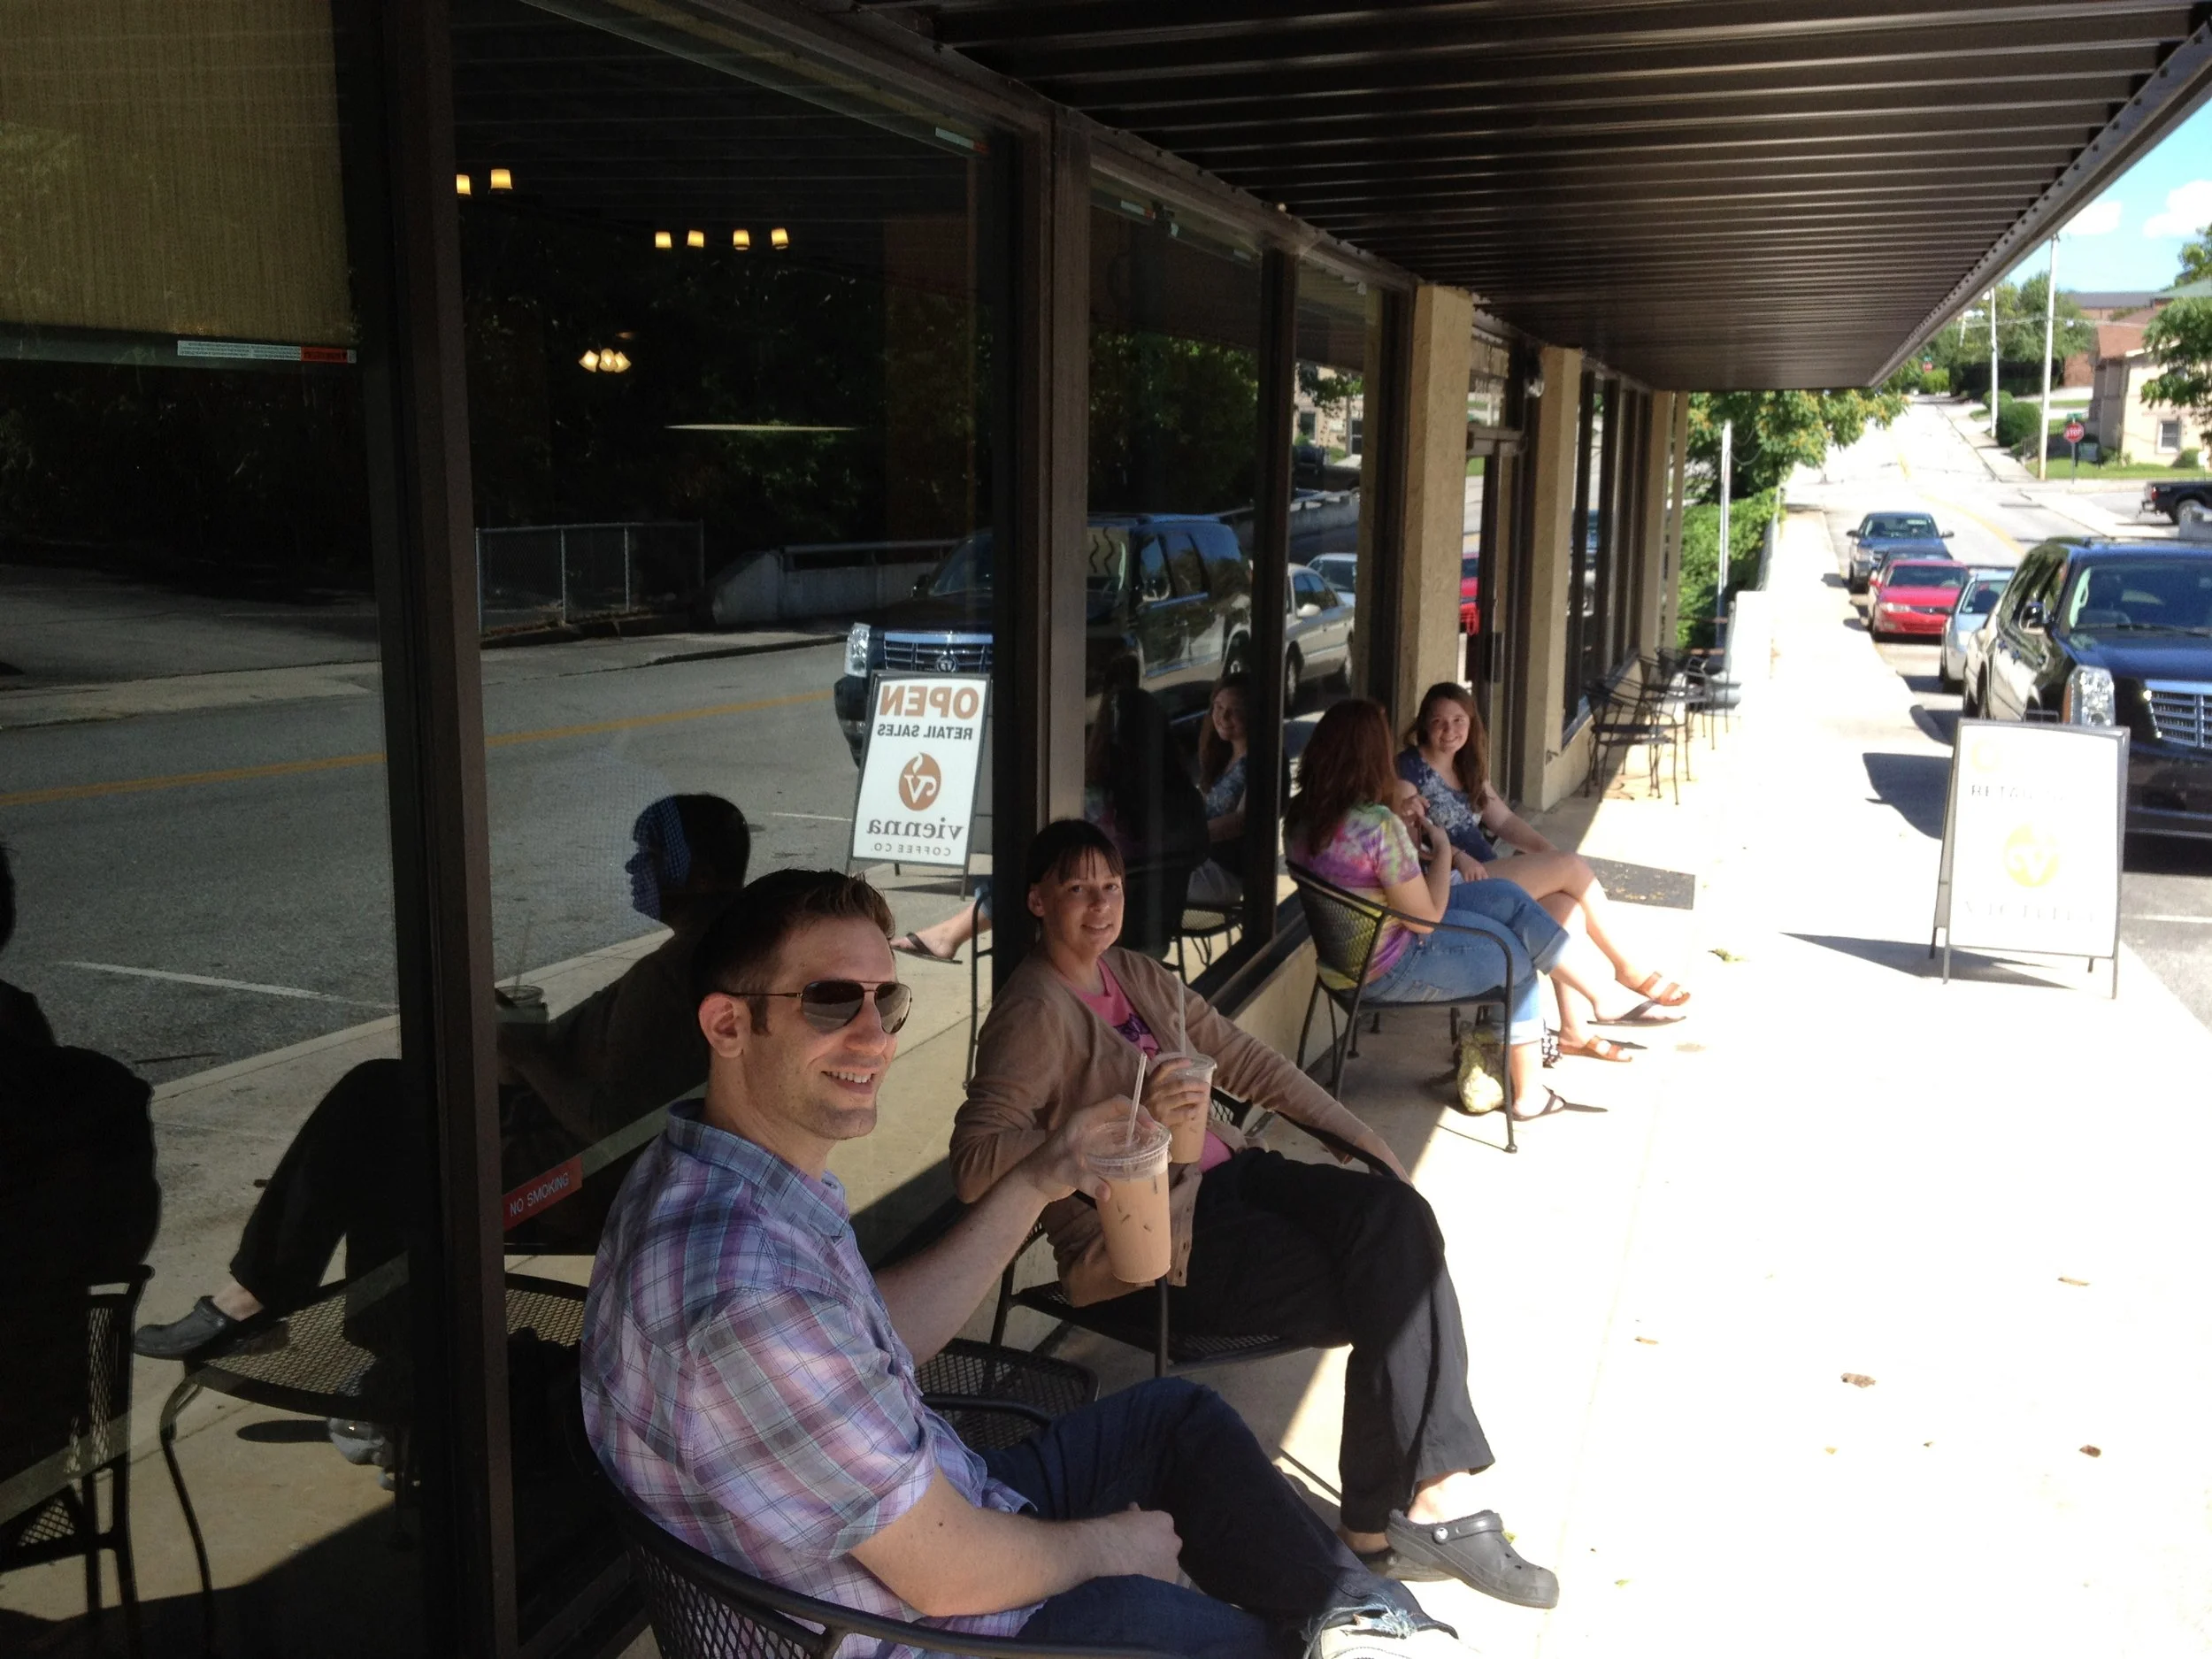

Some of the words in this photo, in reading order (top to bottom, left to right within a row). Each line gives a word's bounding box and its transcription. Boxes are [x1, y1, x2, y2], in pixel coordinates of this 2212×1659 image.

[2065, 427, 2083, 436] STOP
[510, 1198, 524, 1217] NO
[526, 1172, 570, 1207] SMOKING
